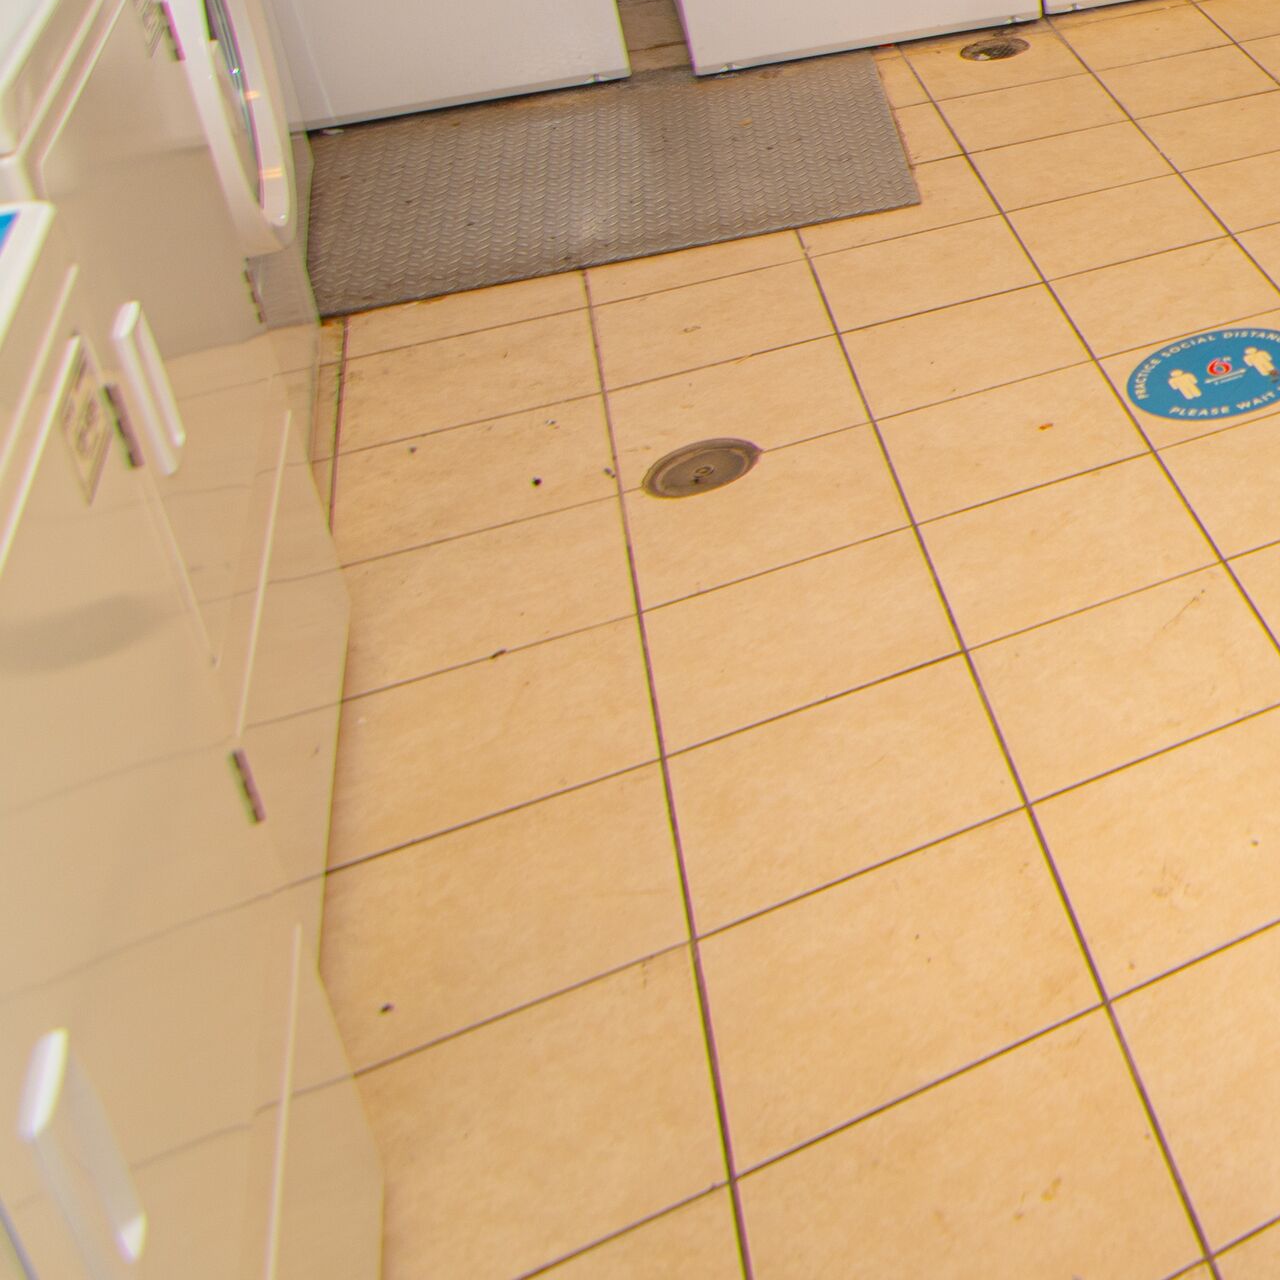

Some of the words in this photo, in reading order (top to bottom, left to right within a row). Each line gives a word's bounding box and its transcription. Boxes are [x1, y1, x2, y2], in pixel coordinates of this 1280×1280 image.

[1161, 335, 1217, 358] SOCIAL
[1169, 405, 1230, 417] PLEASE
[1235, 390, 1276, 411] WAIT
